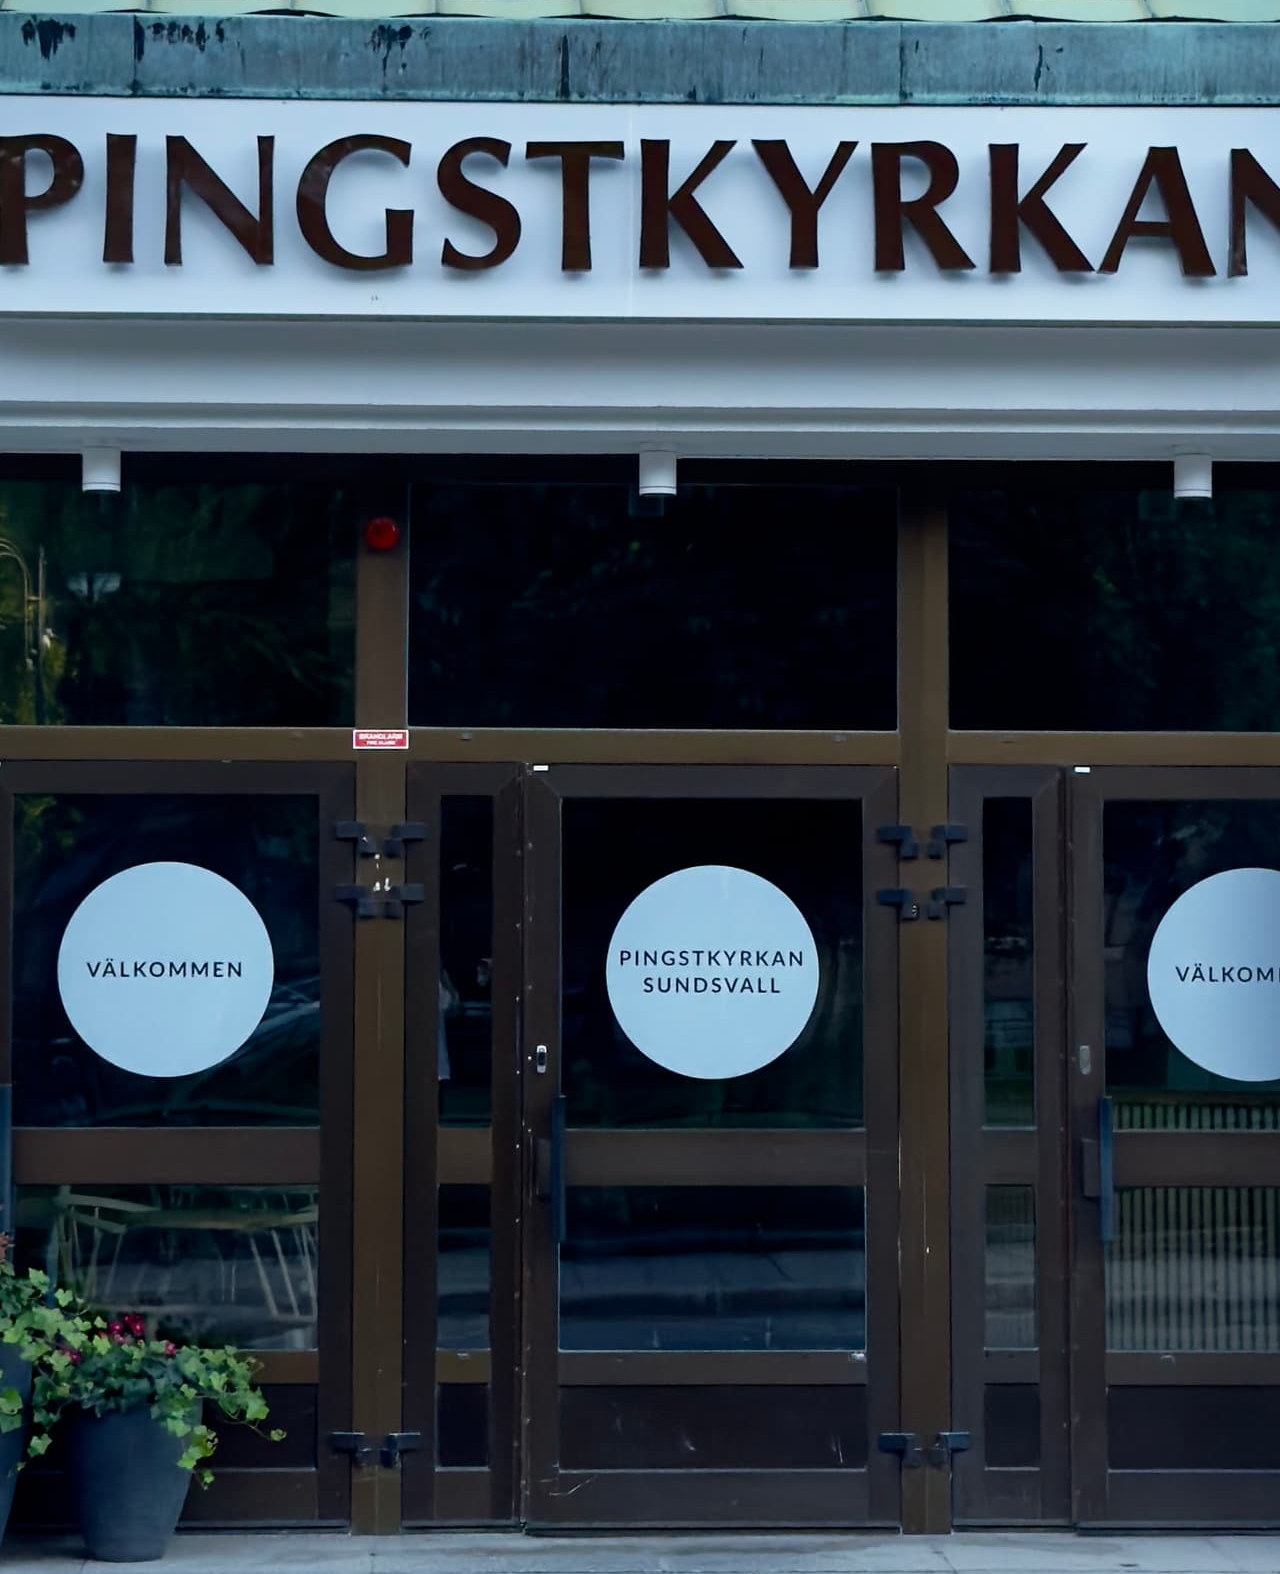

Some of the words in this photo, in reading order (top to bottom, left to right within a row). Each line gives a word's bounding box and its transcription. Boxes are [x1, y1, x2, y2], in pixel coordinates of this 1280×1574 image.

[619, 950, 804, 967] PINGSTKYRKAN
[86, 957, 242, 978] VÄLKOMMEN
[643, 977, 781, 994] SUNDSVALL
